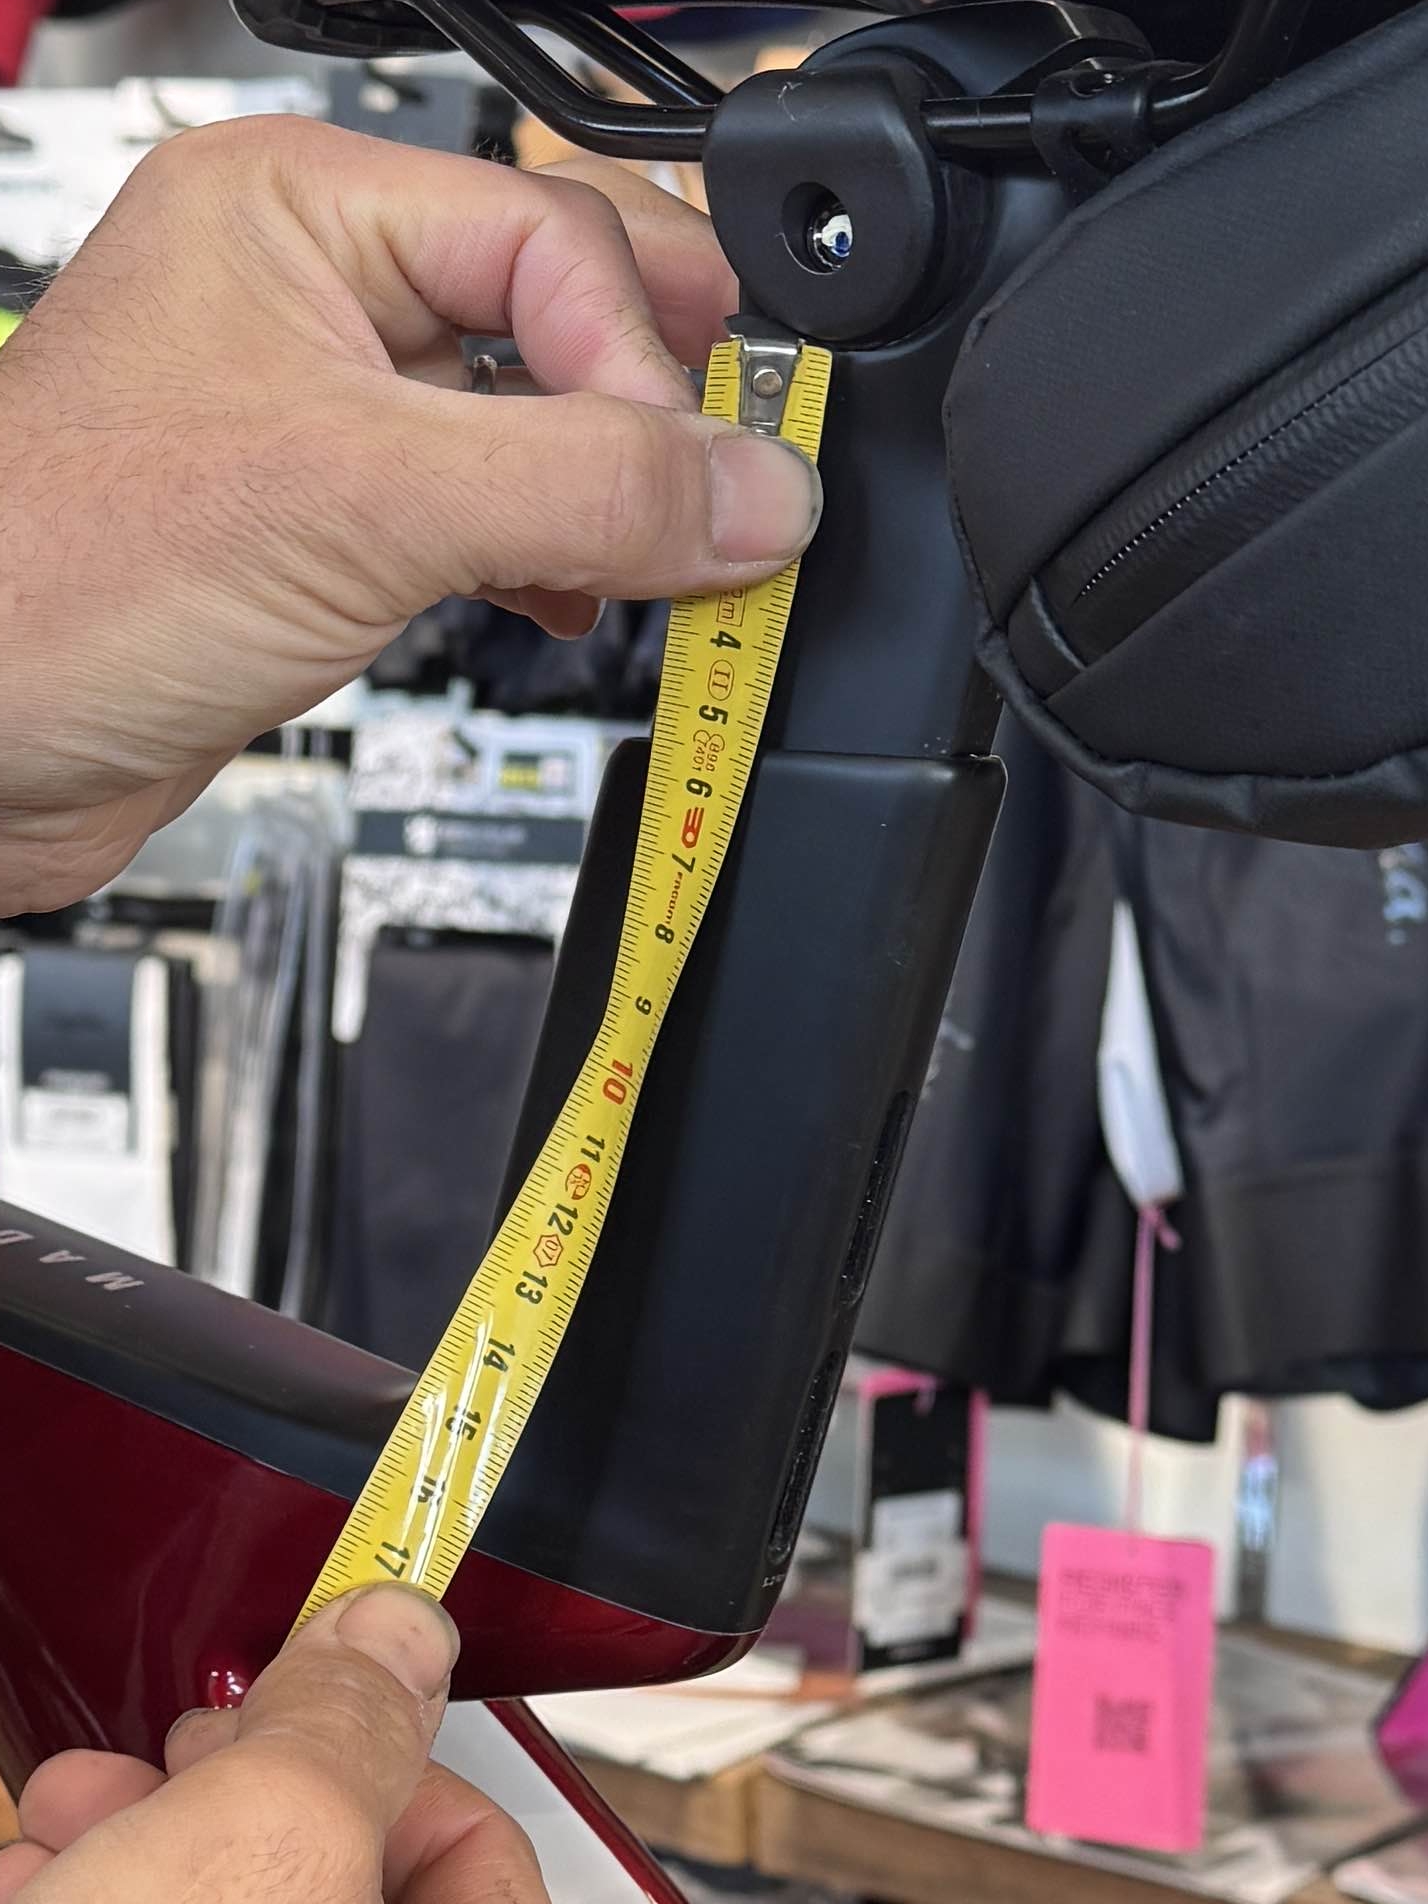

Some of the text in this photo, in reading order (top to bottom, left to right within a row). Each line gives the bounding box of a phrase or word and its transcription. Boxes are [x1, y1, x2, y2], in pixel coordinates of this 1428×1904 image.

[709, 630, 742, 651] 4
[699, 704, 729, 726] 5
[672, 778, 713, 873] 6 7
[655, 923, 675, 944] 8
[635, 996, 652, 1015] 9
[603, 1059, 634, 1105] 10
[580, 1134, 606, 1164] 11
[547, 1203, 579, 1236] 12
[515, 1270, 548, 1305] 13
[483, 1337, 516, 1372] 14
[445, 1404, 482, 1441] 15
[374, 1541, 410, 1578] 17
